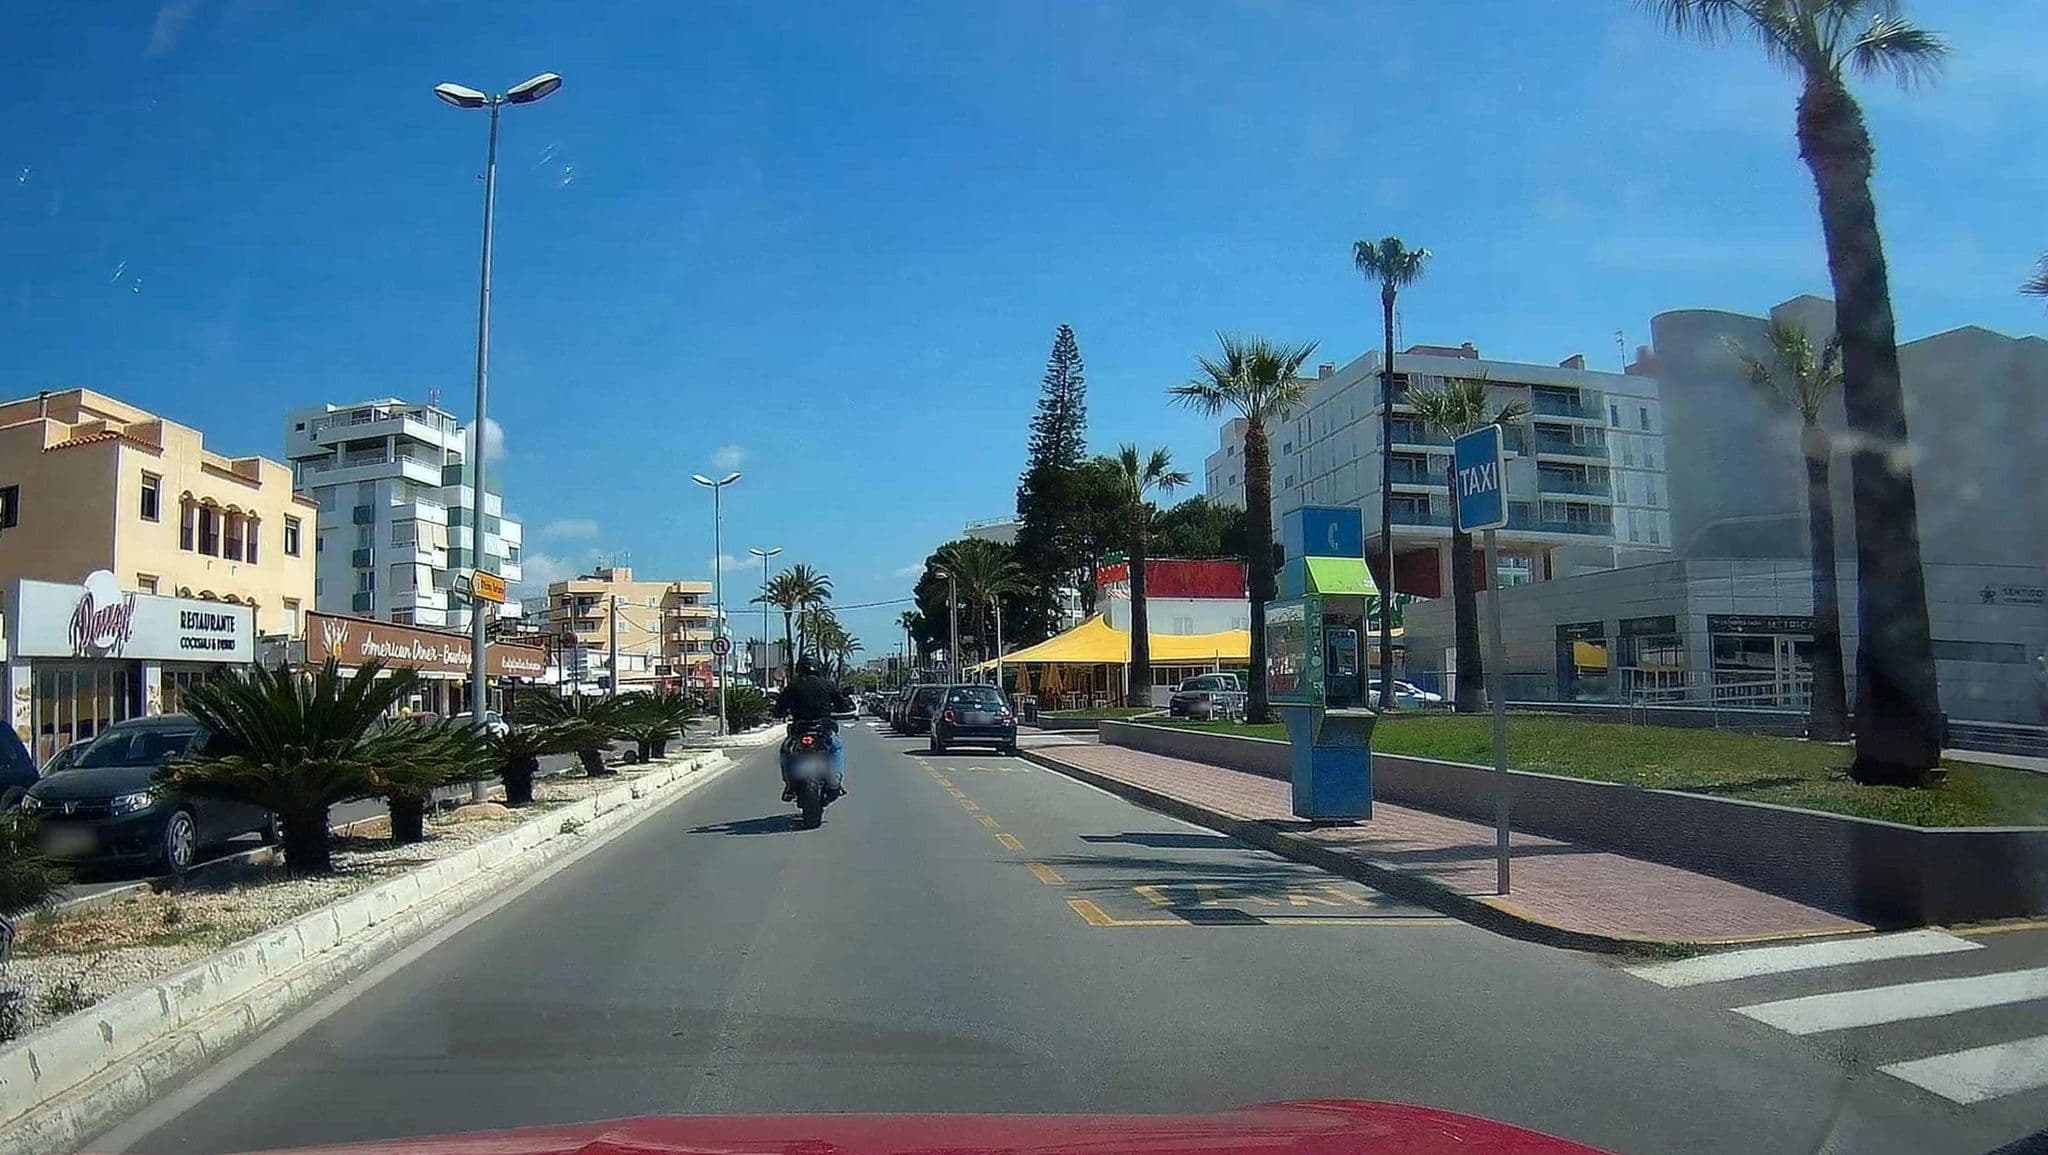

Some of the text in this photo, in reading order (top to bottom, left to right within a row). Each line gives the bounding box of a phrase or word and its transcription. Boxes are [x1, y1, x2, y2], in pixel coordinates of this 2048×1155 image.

[1459, 462, 1498, 496] TAXI
[180, 610, 236, 633] RESTAURANTE
[361, 631, 411, 660] American
[412, 638, 438, 662] Diner
